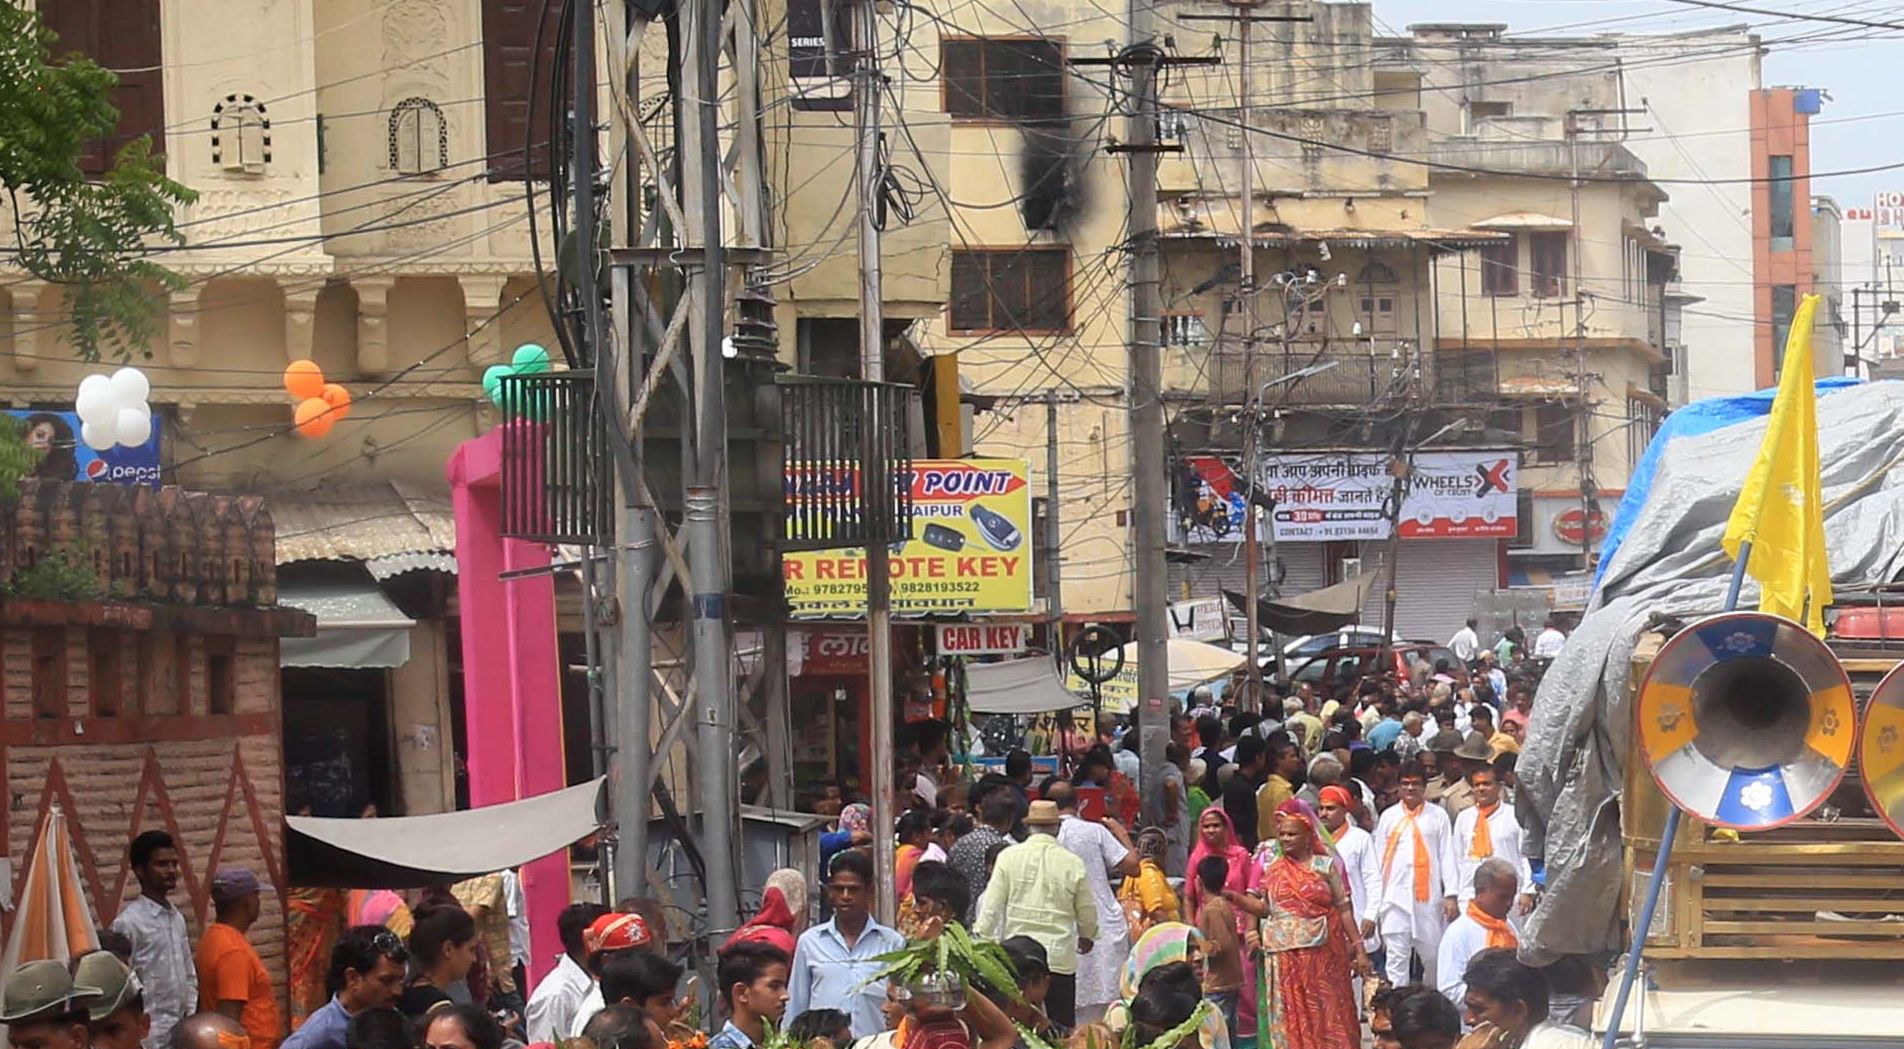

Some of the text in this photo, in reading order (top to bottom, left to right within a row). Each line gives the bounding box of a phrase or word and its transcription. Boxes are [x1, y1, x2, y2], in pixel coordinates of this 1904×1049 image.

[791, 36, 825, 48] SERIES
[112, 464, 160, 483] pepsi
[923, 470, 1011, 494] POINT
[1414, 474, 1474, 490] WHEELS
[957, 556, 1020, 578] KEY
[901, 581, 981, 593] 9828193522
[943, 625, 1020, 650] CAR KEY
